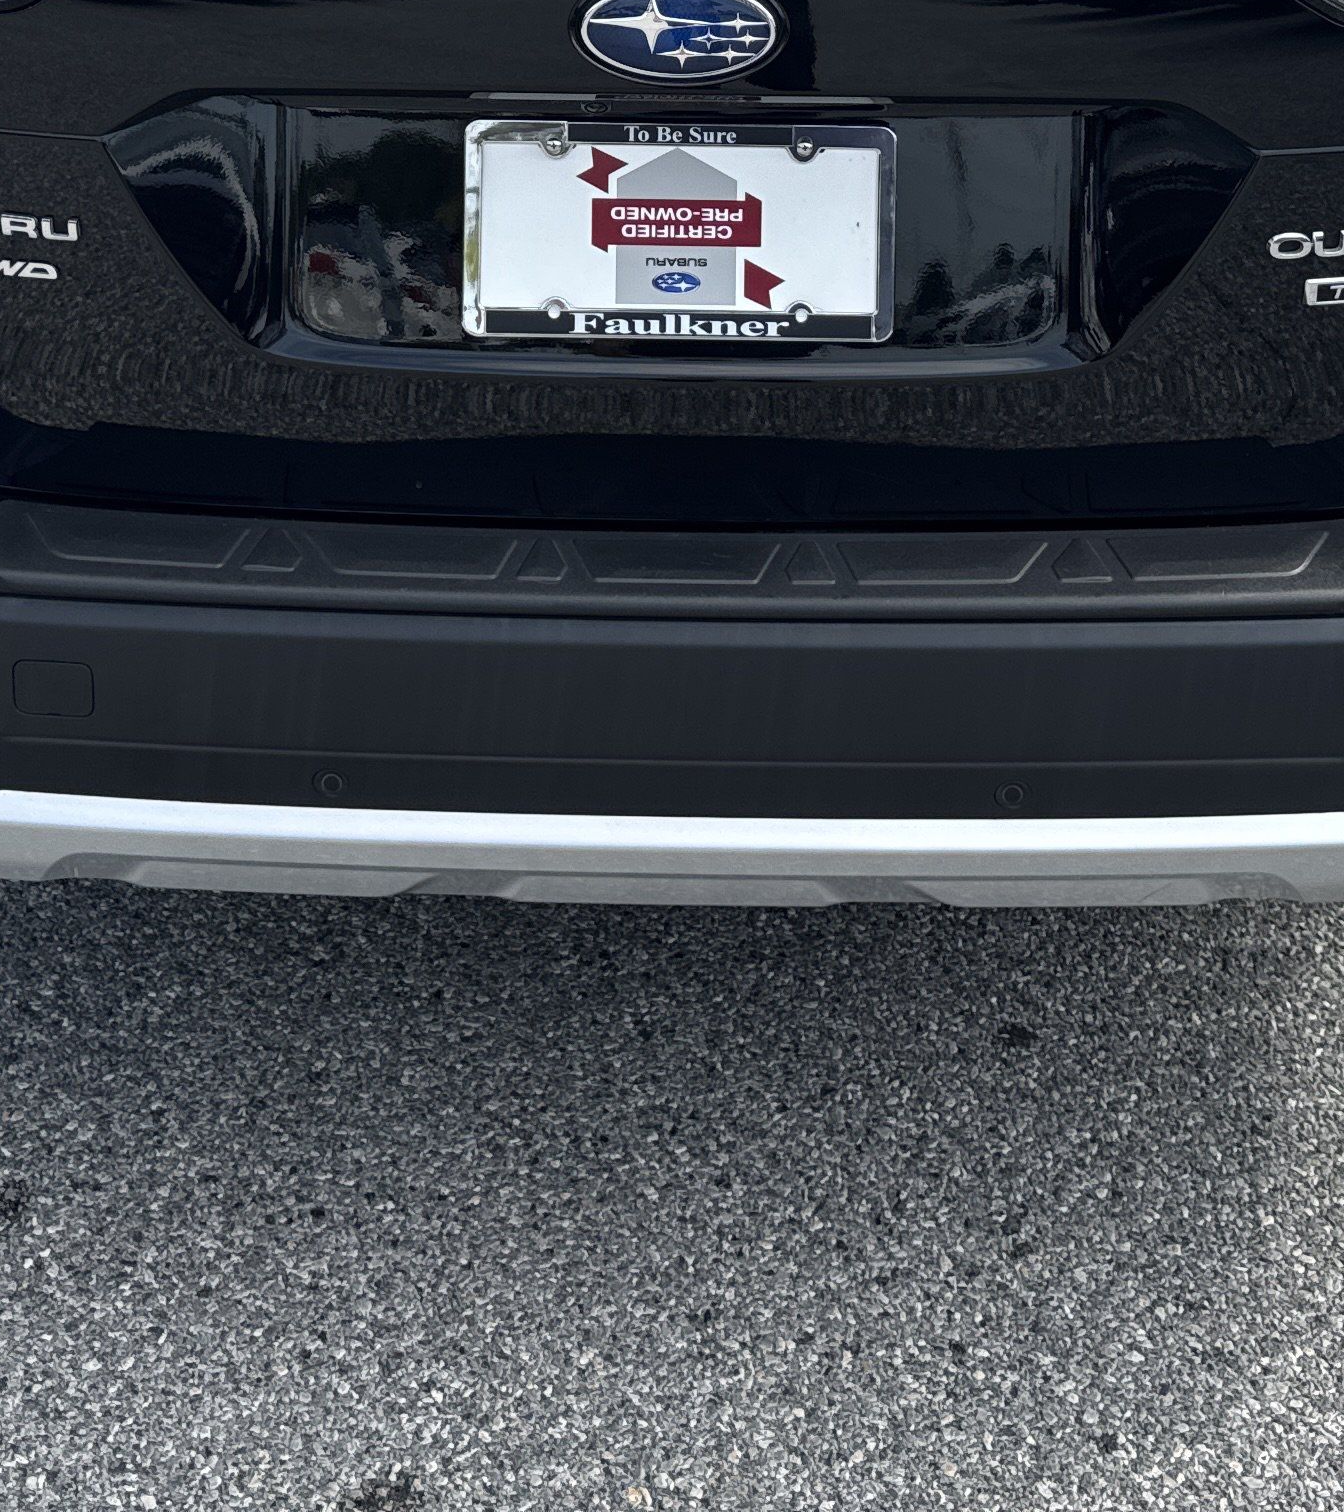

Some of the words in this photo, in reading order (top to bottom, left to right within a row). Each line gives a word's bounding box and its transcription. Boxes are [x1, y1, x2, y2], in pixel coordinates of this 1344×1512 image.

[623, 125, 650, 144] To
[656, 126, 683, 144] Be
[688, 127, 737, 145] Sure
[610, 205, 744, 222] PRE-OWNED
[621, 224, 733, 239] CERTIFIED
[645, 257, 708, 267] SUBARU
[568, 313, 790, 338] Faulkner
